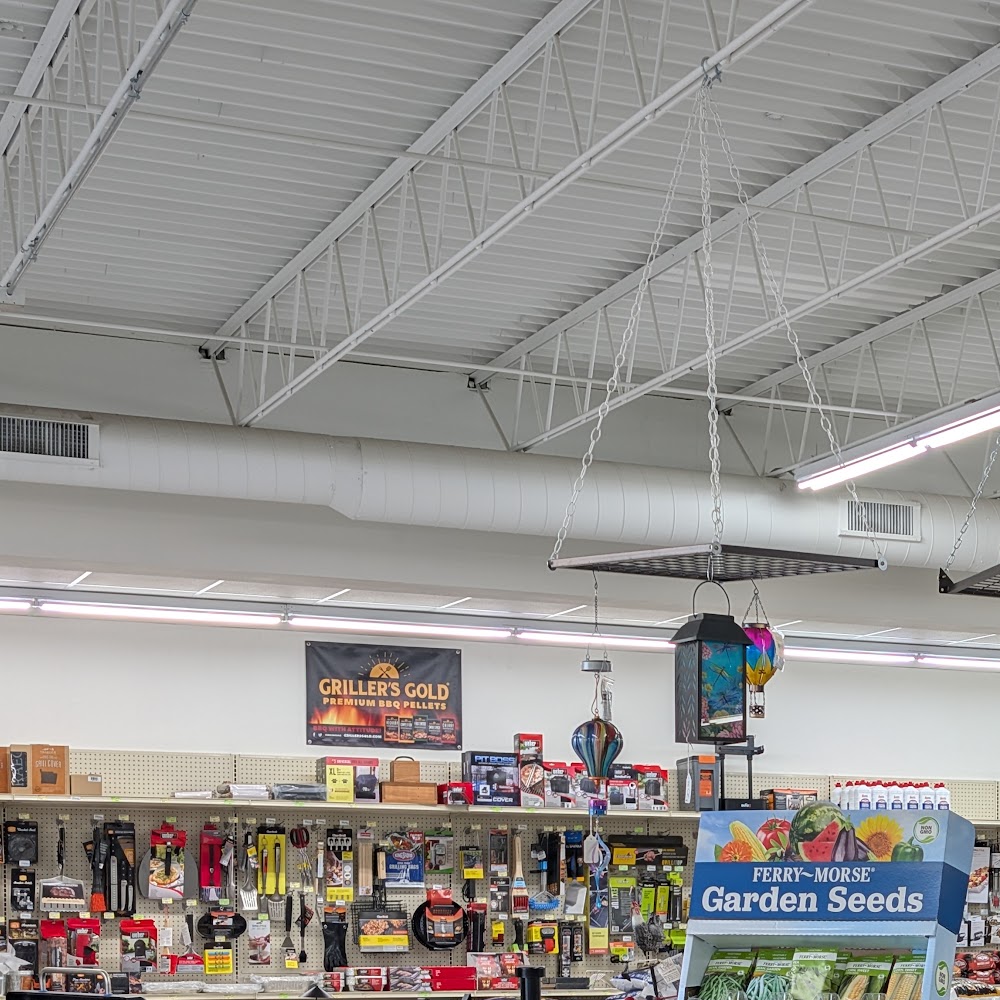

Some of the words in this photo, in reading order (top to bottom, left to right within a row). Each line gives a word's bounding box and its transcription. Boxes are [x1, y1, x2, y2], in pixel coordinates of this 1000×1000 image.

[319, 678, 400, 698] GRILLER'S
[404, 682, 450, 701] GOLD
[322, 697, 376, 708] PREMIUM
[378, 700, 401, 710] BBQ
[403, 701, 447, 710] PELLETS
[702, 886, 818, 913] Garden
[828, 887, 924, 913] Seeds
